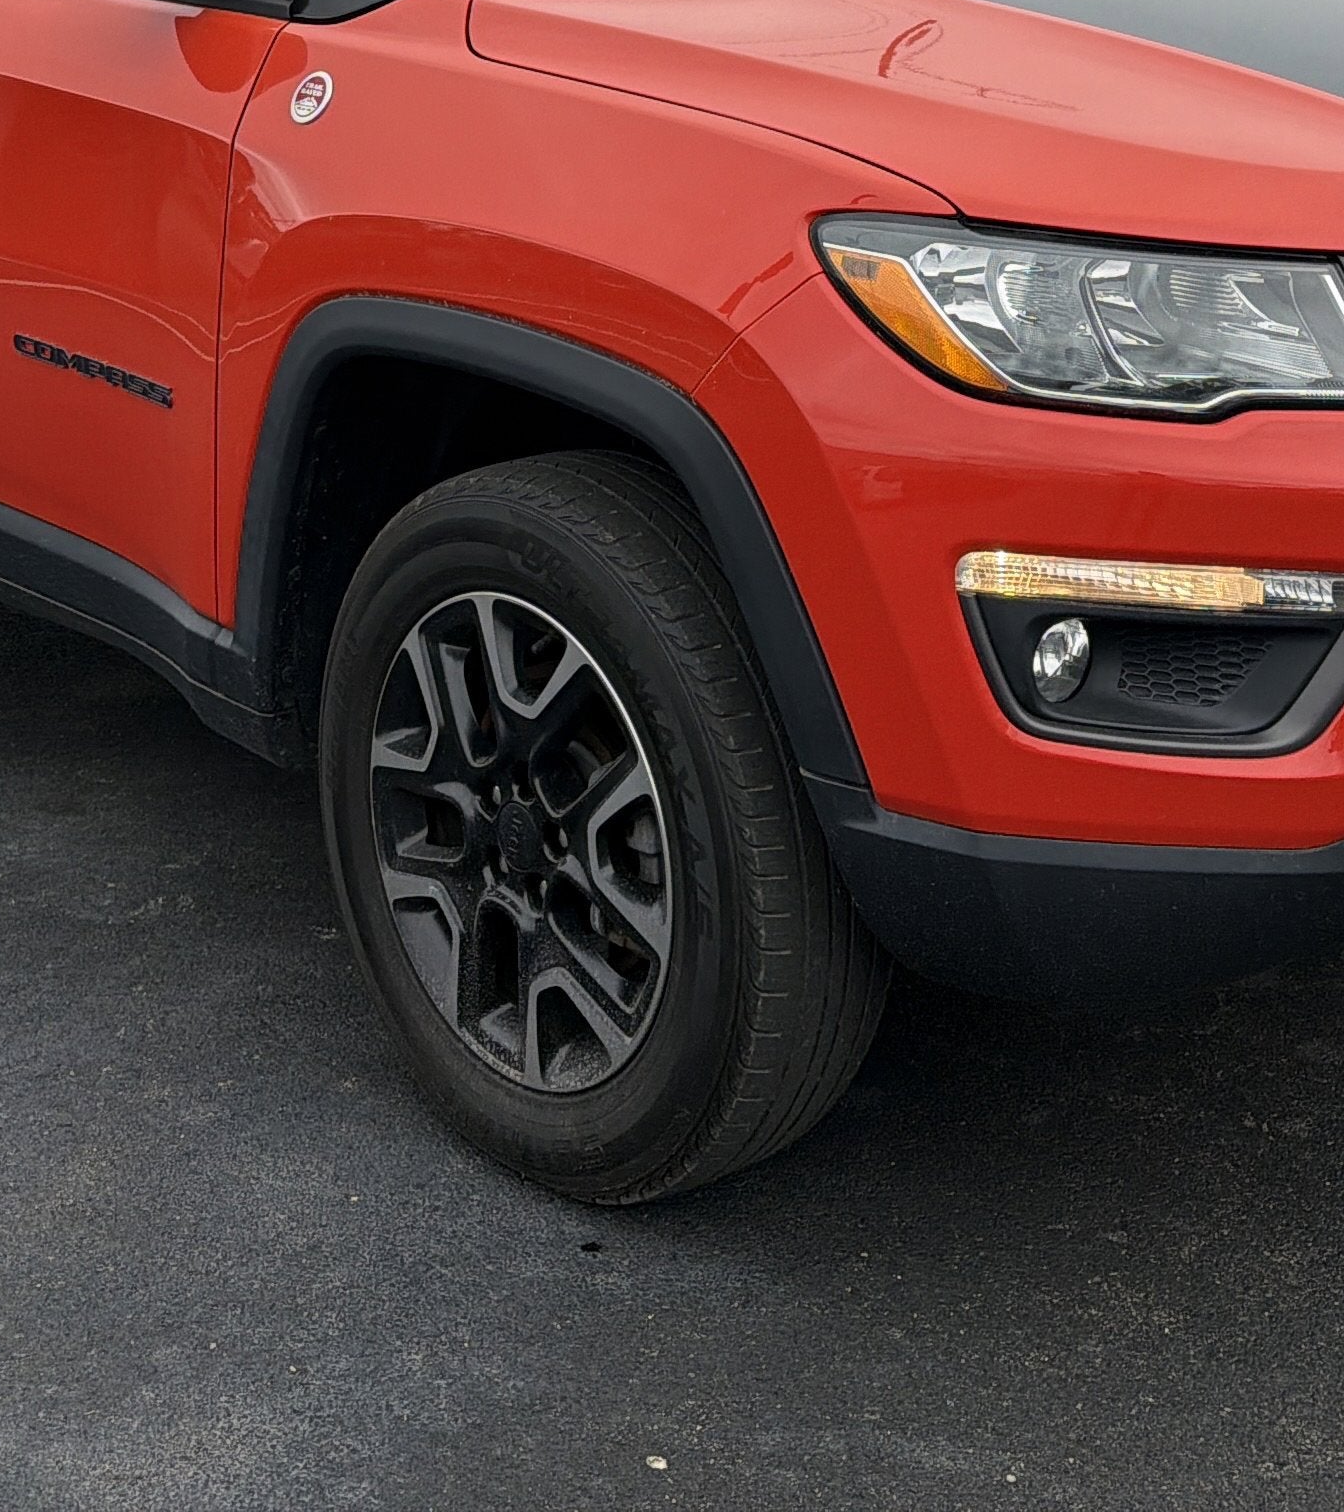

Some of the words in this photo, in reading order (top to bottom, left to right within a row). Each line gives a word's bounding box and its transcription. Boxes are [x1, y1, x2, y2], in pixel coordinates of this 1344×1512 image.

[305, 82, 325, 91] TRAIL
[300, 88, 323, 97] RATED
[13, 334, 174, 409] COMPASS
